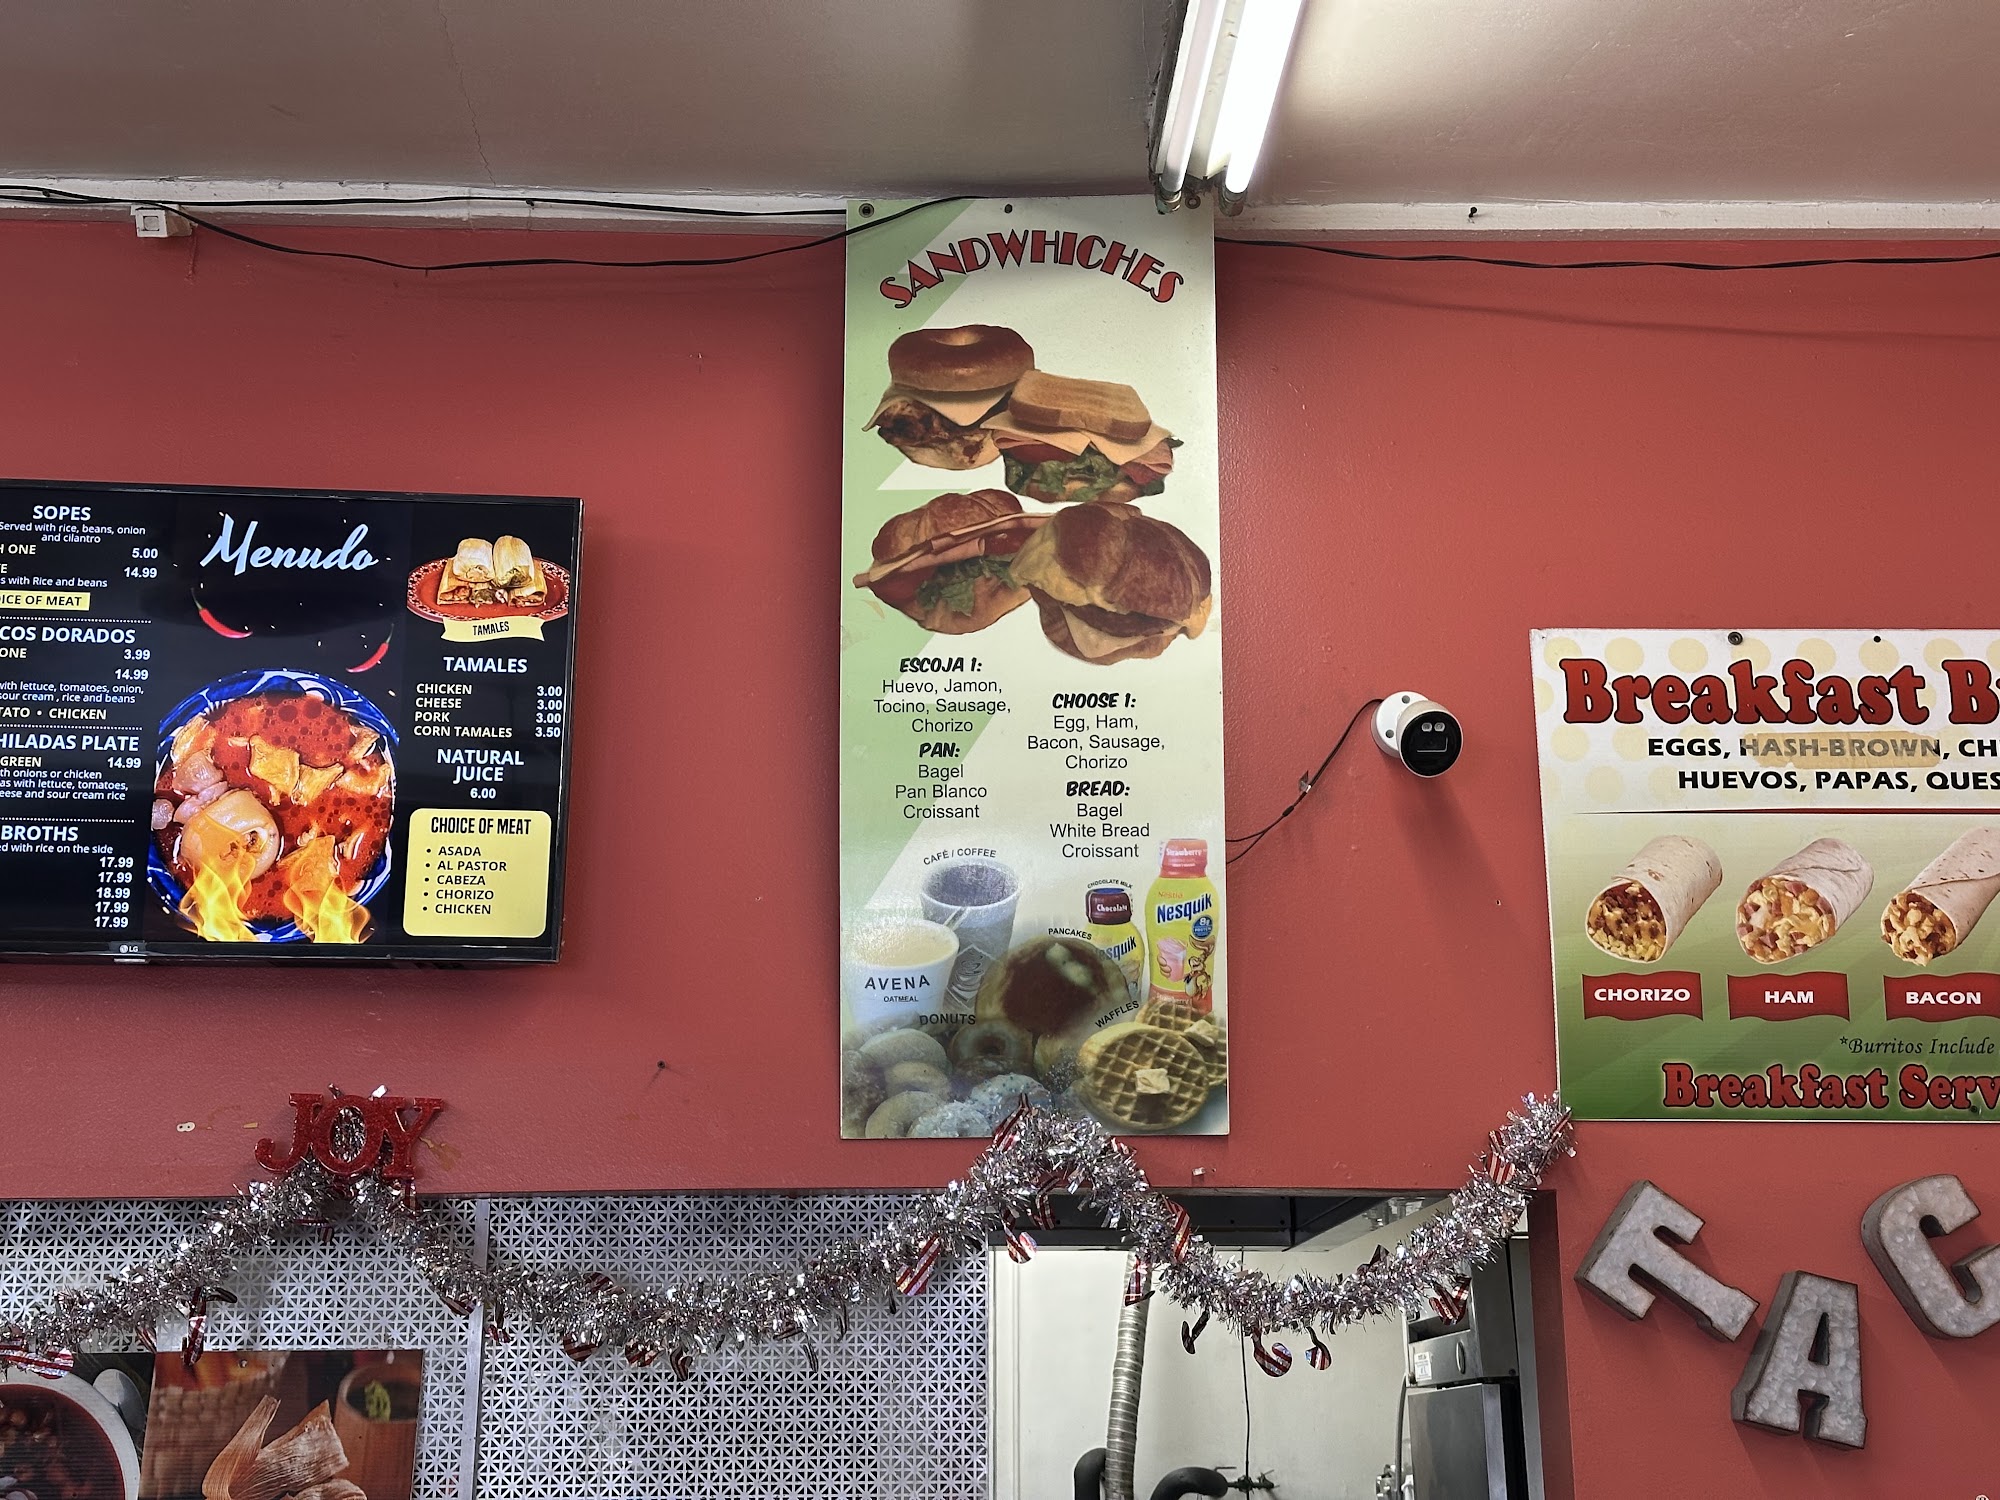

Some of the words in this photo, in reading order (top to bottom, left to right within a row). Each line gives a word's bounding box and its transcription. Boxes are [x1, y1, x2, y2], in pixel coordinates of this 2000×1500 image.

[879, 228, 1184, 309] SANDWHICHES
[33, 505, 91, 521] SOPES
[0, 522, 32, 531] Served
[35, 523, 56, 532] with
[58, 524, 79, 534] rice,
[82, 524, 114, 535] beans,
[117, 526, 146, 535] onion
[41, 533, 60, 542] and
[63, 534, 101, 543] cilantro
[200, 513, 379, 576] Menudo
[8, 544, 37, 555] ONE
[132, 547, 158, 559] 5.00
[124, 566, 158, 578] 14.99
[8, 576, 30, 585] with
[32, 577, 53, 586] Rice
[55, 578, 75, 587] and
[77, 578, 108, 587] beans
[0, 594, 21, 605] ICE
[25, 595, 42, 605] OF
[46, 596, 82, 606] MEAT
[0, 626, 37, 641] COS
[41, 627, 136, 644] DORADOS
[472, 621, 510, 636] TAMALES
[0, 648, 27, 658] ONE
[123, 649, 151, 660] 3.99
[443, 656, 528, 673] TAMALES
[900, 657, 964, 673] ESCOJA
[114, 669, 149, 680] 14.99
[20, 681, 57, 692] lettuce,
[59, 683, 110, 693] tomatoes,
[112, 684, 144, 694] onion,
[416, 683, 472, 695] CHICKEN
[536, 685, 563, 697] 3.00
[882, 679, 938, 694] Huevo,
[943, 678, 1002, 694] Jamon,
[1559, 658, 1929, 725] Breakfast
[1941, 659, 2000, 725] B
[22, 693, 54, 701] cream
[62, 693, 81, 702] rice
[83, 694, 102, 703] and
[104, 694, 136, 704] beans
[415, 697, 462, 709] CHEESE
[536, 699, 563, 711] 3.00
[1052, 692, 1119, 709] CHOOSE
[873, 699, 930, 715] Tocino,
[935, 698, 1011, 715] Sausage,
[49, 708, 107, 720] CHICKEN
[414, 712, 450, 723] PORK
[535, 713, 562, 724] 3.00
[911, 718, 974, 733] Chorizo
[1053, 715, 1090, 732] Egg,
[1096, 715, 1139, 730] Ham,
[413, 725, 450, 737] CORN
[454, 726, 513, 739] TAMALES
[535, 727, 561, 738] 3.50
[81, 735, 139, 751] PLATE
[919, 742, 960, 758] PAN:
[1027, 735, 1083, 751] Bacon,
[1089, 735, 1165, 752] Sausage,
[1648, 738, 1731, 760] EGGS,
[1739, 738, 1950, 760] HASH-BROWN,
[1958, 739, 2000, 757] CH
[0, 756, 42, 767] GREEN
[107, 757, 141, 768] 14.99
[437, 749, 525, 765] NATURAL
[1065, 755, 1128, 769] Chorizo
[13, 769, 47, 778] onions
[63, 769, 102, 779] chicken
[453, 766, 504, 785] JUICE
[918, 764, 964, 781] Bagel
[13, 779, 35, 788] with
[38, 780, 75, 790] lettuce,
[77, 781, 129, 791] tomatoes,
[1066, 780, 1130, 796] BREAD:
[1678, 771, 1807, 793] HUEVOS,
[1815, 771, 1918, 793] PAPAS,
[1926, 771, 2000, 791] QUES
[24, 790, 45, 798] and
[47, 791, 70, 799] sour
[72, 792, 104, 800] cream
[107, 791, 126, 800] rice
[470, 788, 497, 799] 6.00
[895, 785, 927, 799] Pan
[932, 784, 987, 798] Blanco
[903, 804, 980, 819] Croissant
[1077, 803, 1123, 820] Bagel
[431, 816, 475, 834] CHOICE
[478, 818, 494, 834] OF
[497, 818, 531, 835] MEAT
[1050, 823, 1096, 838] White
[1102, 823, 1150, 838] Bread
[1, 825, 79, 841] BROTHS
[10, 843, 33, 853] with
[35, 843, 55, 853] rice
[56, 845, 70, 853] on
[72, 844, 90, 853] the
[91, 844, 114, 854] side
[438, 846, 482, 857] ASADA
[957, 848, 997, 858] COFFEE
[1062, 843, 1139, 858] Croissant
[99, 856, 134, 868] 17.99
[437, 861, 454, 871] AL
[457, 861, 507, 872] PASTOR
[98, 872, 133, 883] 17.99
[437, 875, 486, 886] CABEZA
[1087, 879, 1119, 889] CHOCOLATE
[1120, 880, 1133, 889] MILK
[96, 887, 131, 899] 18.99
[436, 889, 494, 900] CHORIZO
[94, 902, 130, 913] 17.99
[435, 903, 491, 915] CHICKEN
[1157, 893, 1212, 924] Nesquik
[93, 916, 129, 928] 17.99
[1048, 927, 1093, 941] PANCAKES
[864, 974, 931, 991] AVENA
[883, 995, 919, 1003] OATMEAL
[1594, 988, 1691, 1002] CHORIZO
[1764, 991, 1814, 1004] HAM
[1906, 992, 1982, 1005] BACON
[919, 1013, 977, 1026] DONUTS
[1094, 1000, 1140, 1028] WAFFLES
[1929, 1035, 1995, 1055] Include
[1661, 1063, 1890, 1109] Breakfast
[1899, 1063, 2000, 1109] Serv
[255, 1092, 445, 1178] JOY
